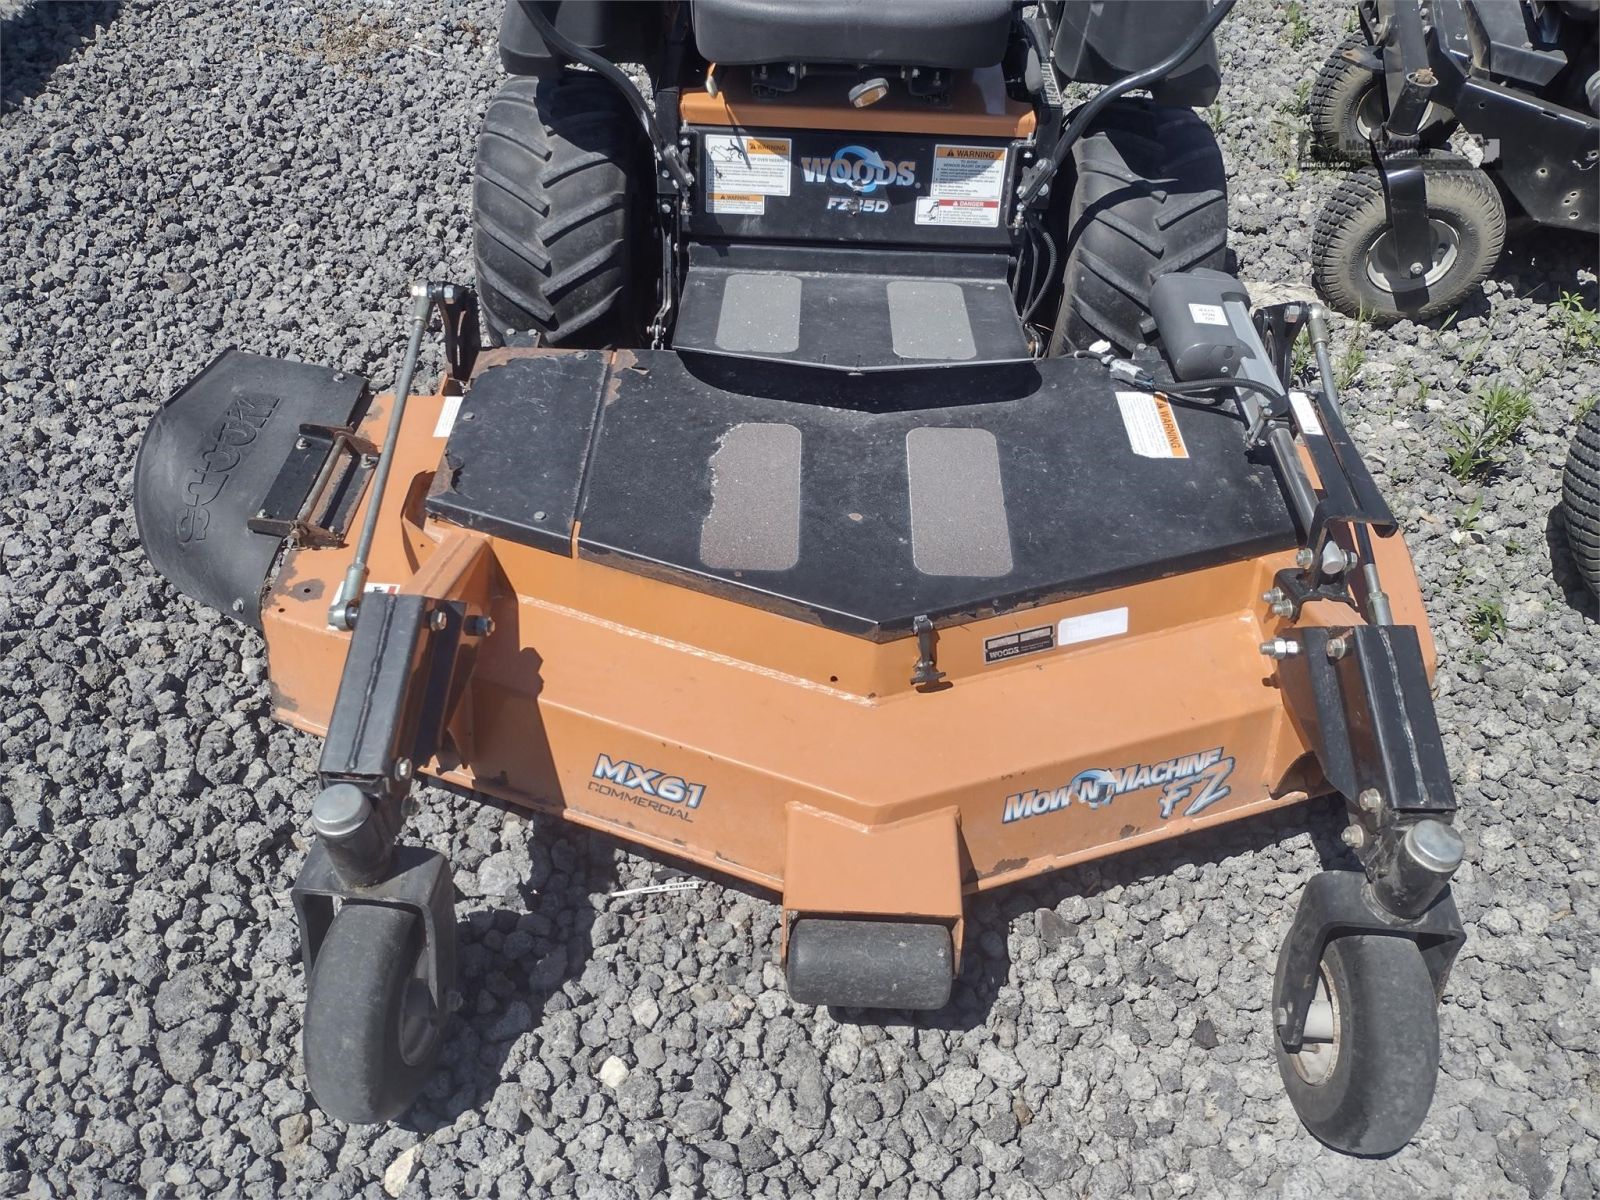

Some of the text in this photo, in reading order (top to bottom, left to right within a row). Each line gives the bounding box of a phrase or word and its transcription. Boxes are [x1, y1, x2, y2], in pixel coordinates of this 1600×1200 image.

[800, 157, 916, 187] WOODS
[957, 150, 995, 159] WARNING
[1160, 410, 1181, 448] WARNING
[989, 646, 1020, 659] WOODS
[592, 753, 707, 809] MX61
[1108, 747, 1224, 796] MACHINE
[587, 780, 694, 823] COMMERCIAL
